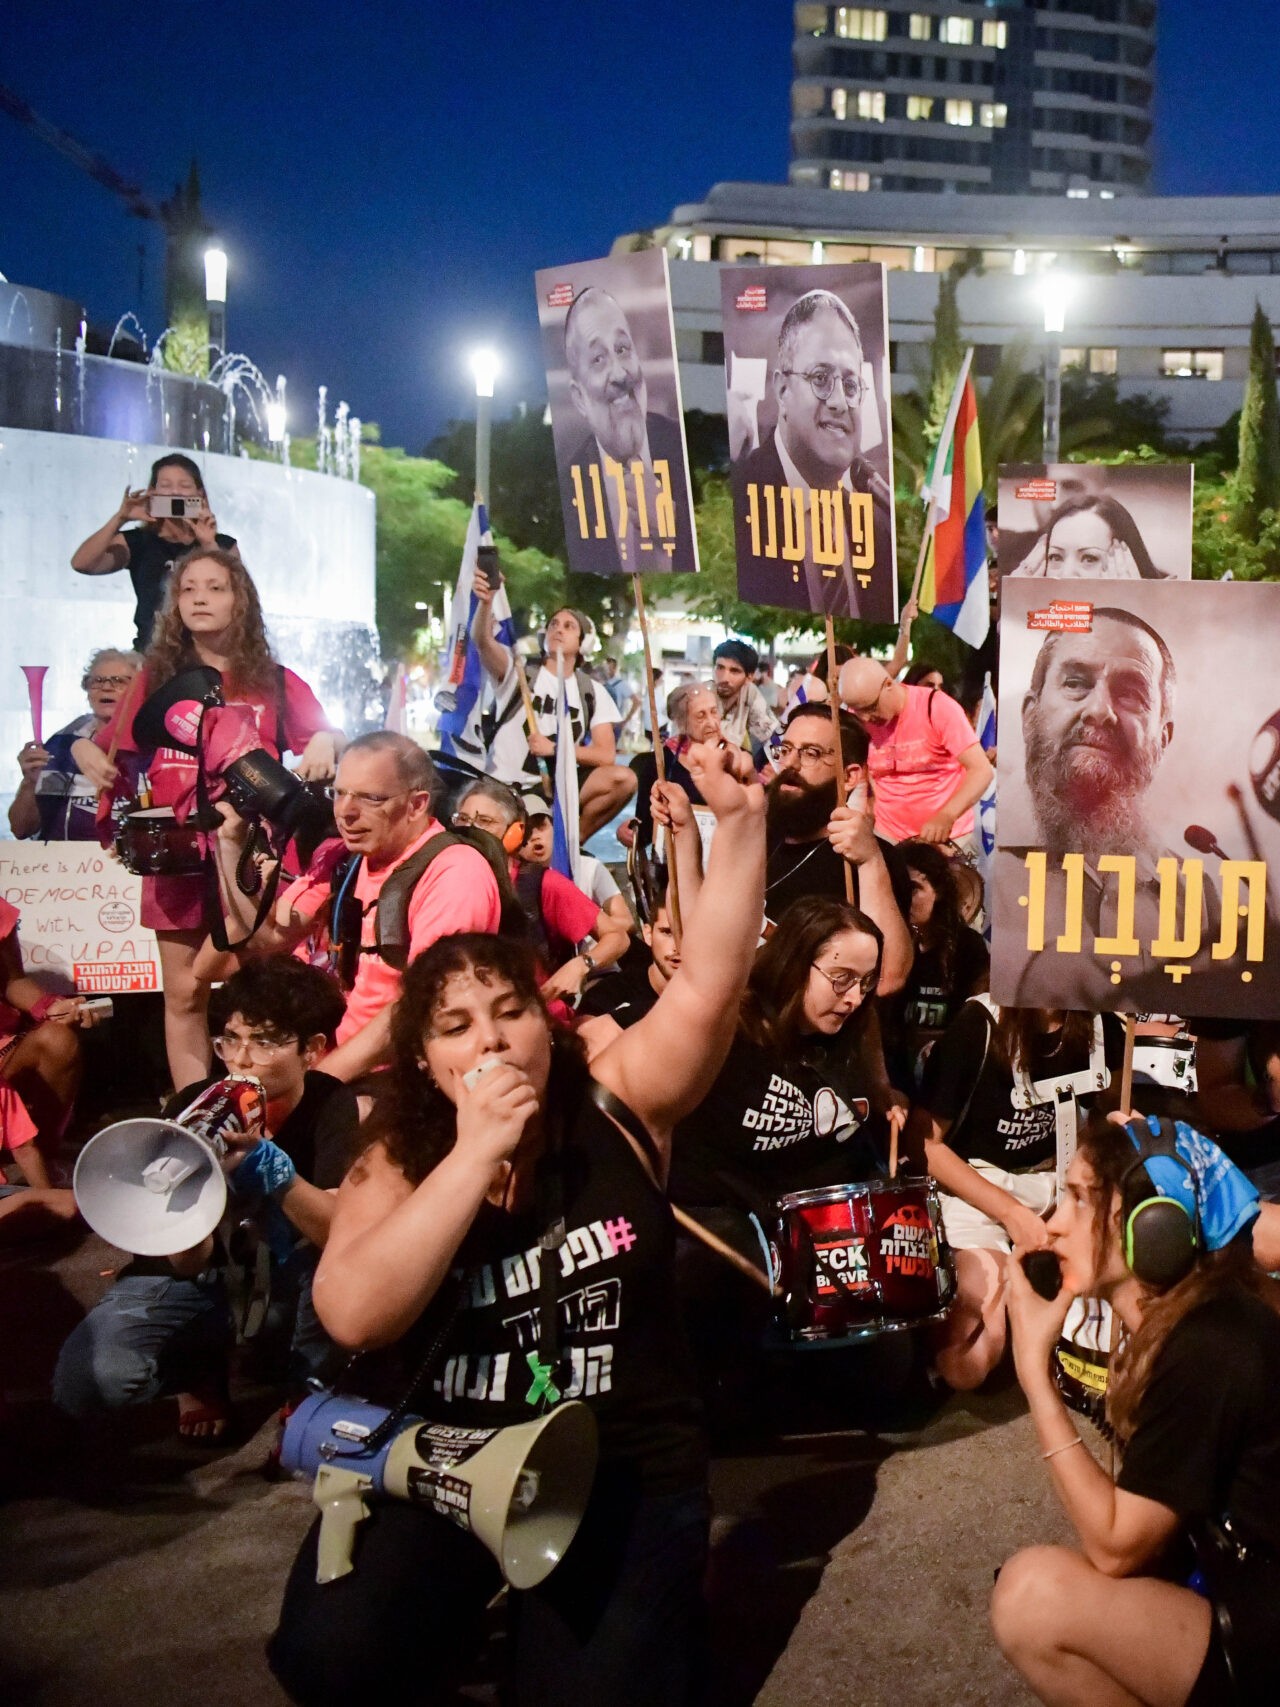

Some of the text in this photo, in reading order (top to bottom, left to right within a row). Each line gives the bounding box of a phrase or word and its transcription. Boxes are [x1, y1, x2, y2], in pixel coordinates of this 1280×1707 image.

[57, 861, 68, 873] is
[76, 857, 104, 874] NO
[5, 884, 137, 904] DEMOCRAC
[76, 963, 153, 975] חובה להתנגד
[77, 974, 154, 991] לדיקטטורה
[762, 1093, 813, 1119] הפיכה
[742, 1107, 813, 1132] קיבלתם
[753, 1130, 810, 1151] מחאה
